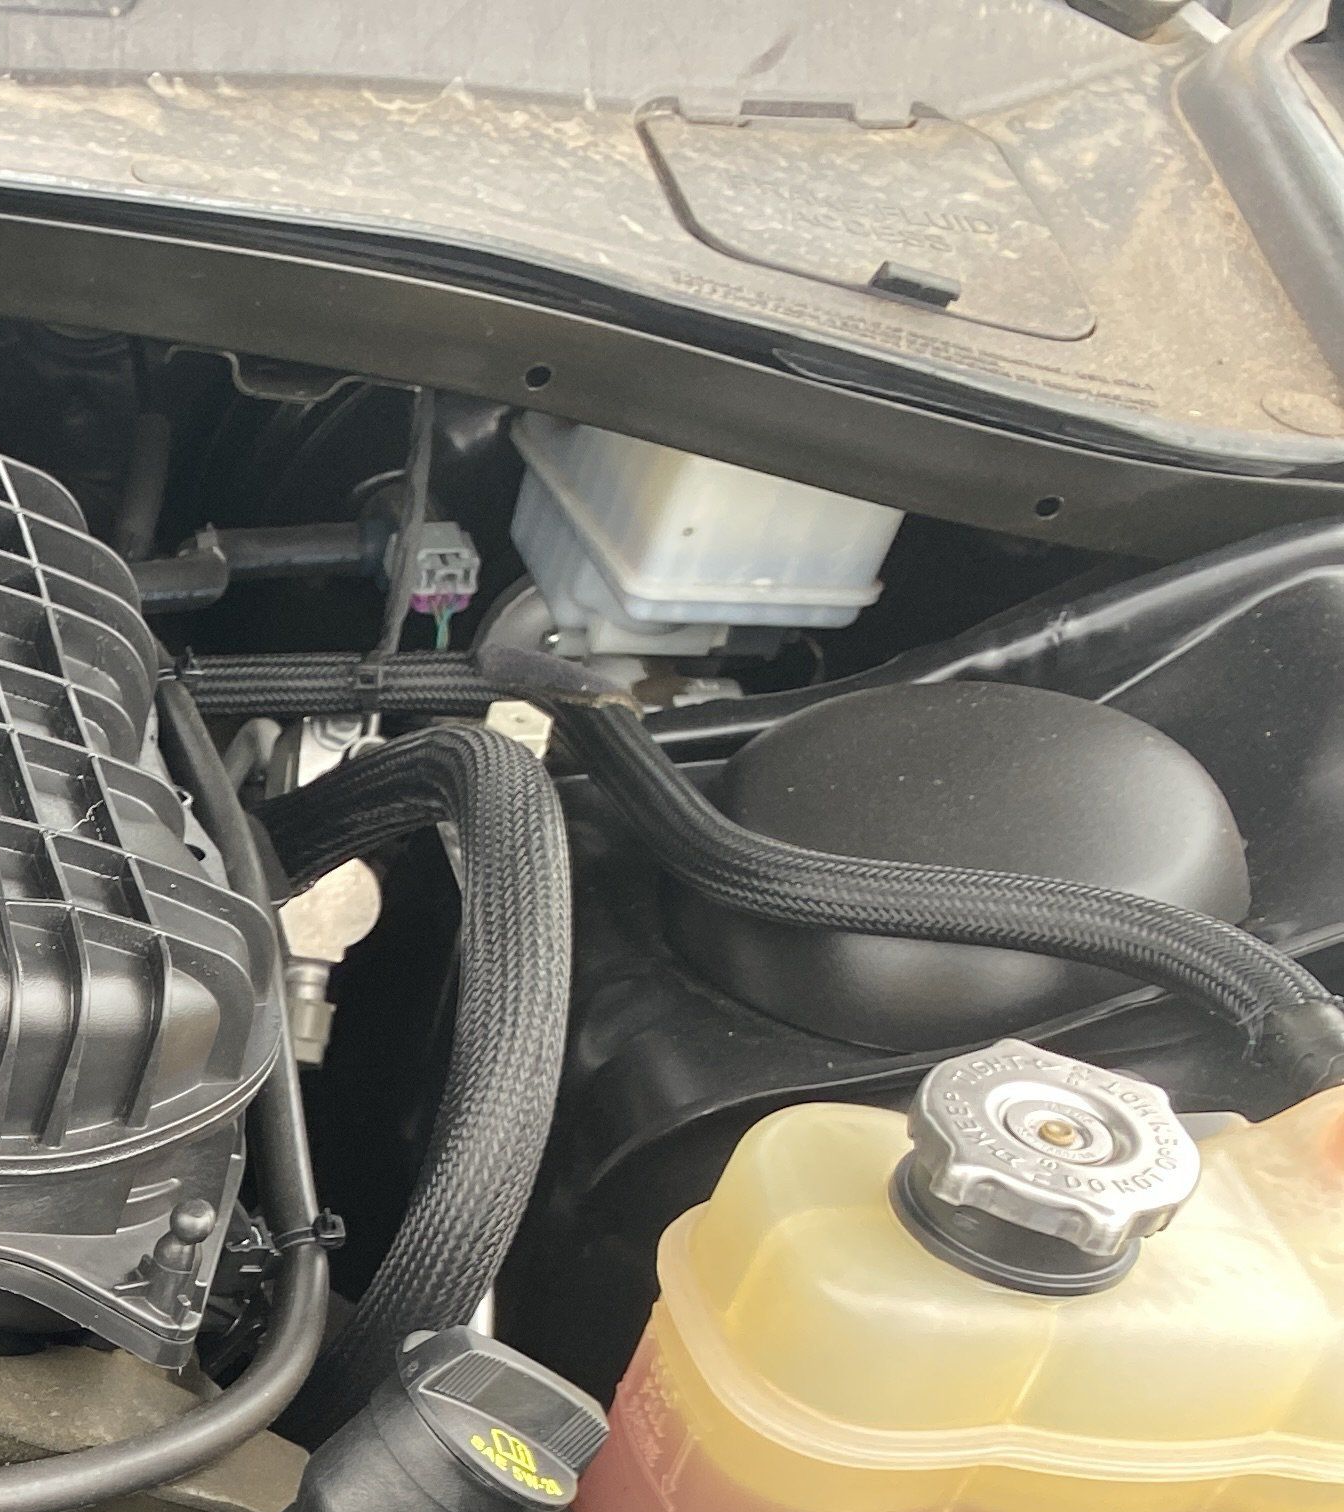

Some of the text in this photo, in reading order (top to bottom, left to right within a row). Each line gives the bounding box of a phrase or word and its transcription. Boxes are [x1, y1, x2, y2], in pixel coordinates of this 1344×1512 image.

[796, 210, 953, 252] ACCESS
[873, 203, 998, 235] FLUID
[944, 1055, 1024, 1146] KEEP TIGHT
[1064, 1174, 1106, 1193] DO
